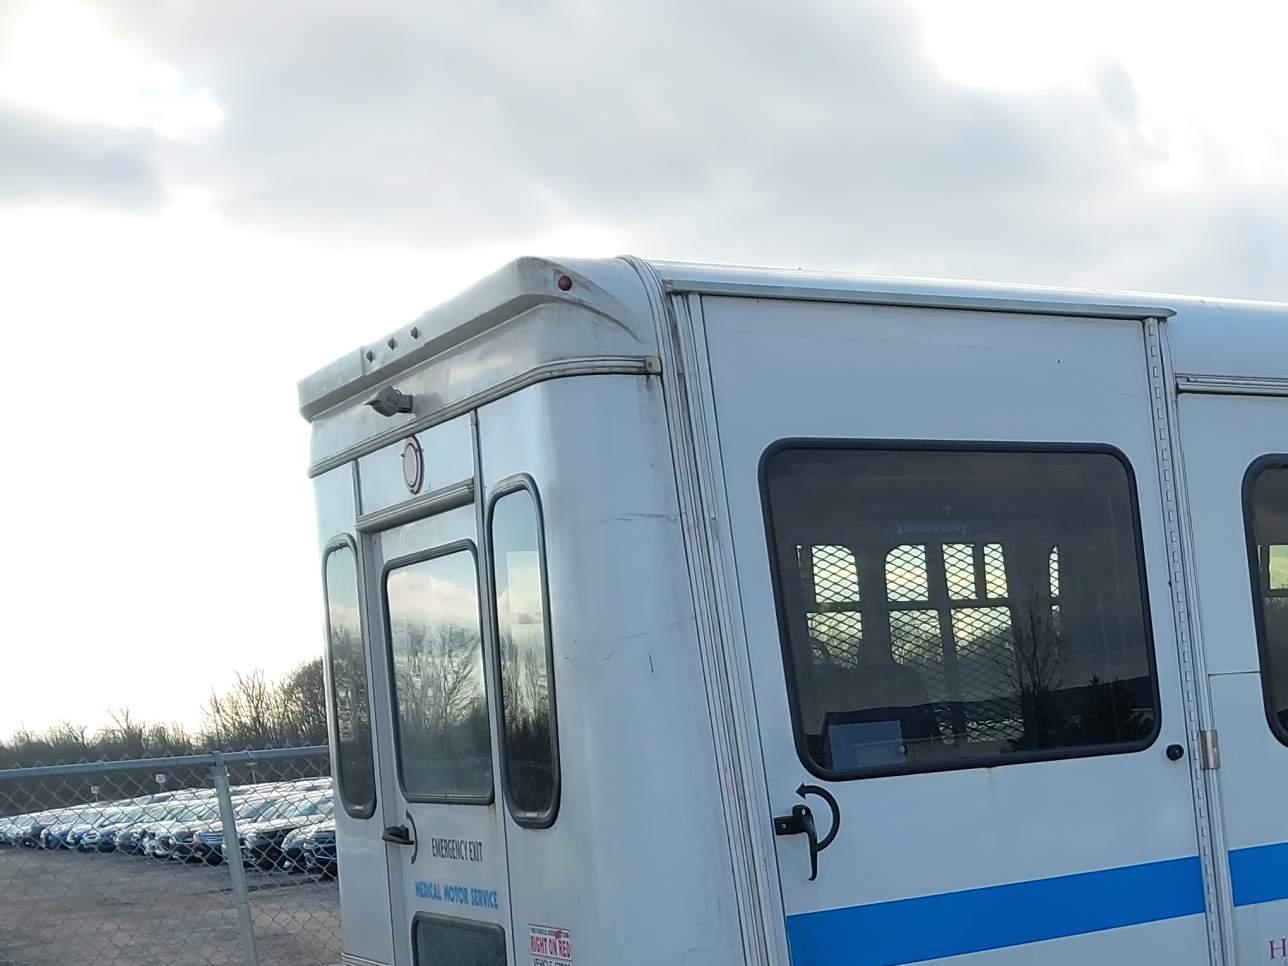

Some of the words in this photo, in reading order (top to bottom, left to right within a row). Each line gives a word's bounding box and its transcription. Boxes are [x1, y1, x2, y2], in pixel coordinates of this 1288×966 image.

[431, 837, 468, 861] EMERGENCY
[468, 840, 483, 863] EXIT
[415, 880, 442, 901] MEDICAL
[443, 884, 469, 905] MOTOR
[470, 887, 498, 910] SERVICE
[530, 935, 548, 954] RIGHT
[548, 937, 558, 956] ON
[558, 939, 571, 958] RED
